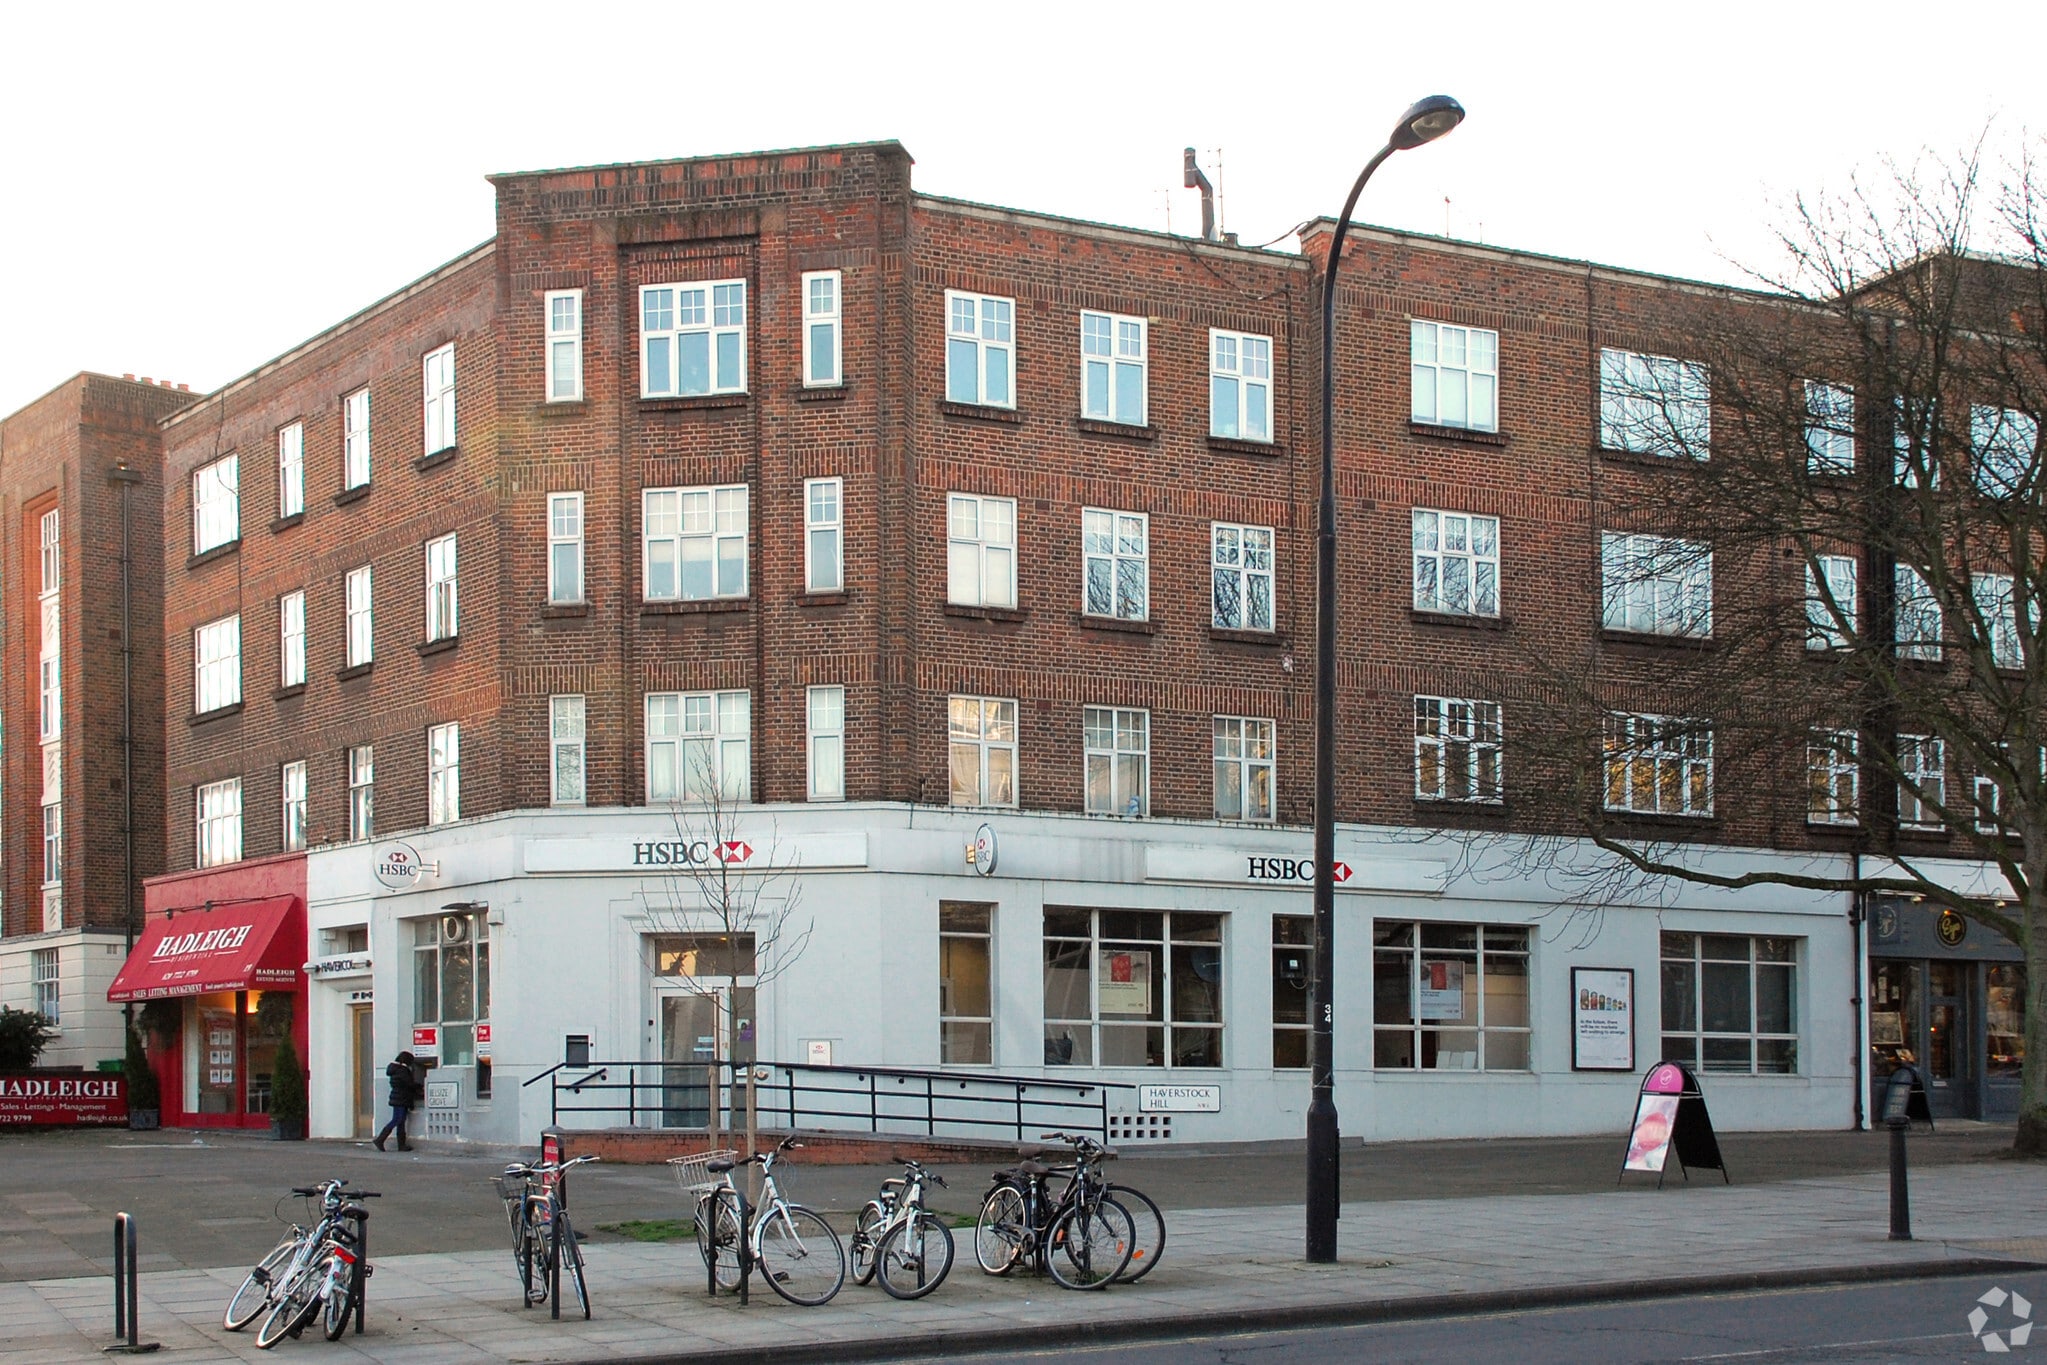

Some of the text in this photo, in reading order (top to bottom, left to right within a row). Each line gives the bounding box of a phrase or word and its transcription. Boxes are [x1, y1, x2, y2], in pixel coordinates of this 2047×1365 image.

[632, 842, 709, 865] HSBC
[380, 864, 417, 876] HSBC
[1247, 857, 1315, 881] HSBC
[152, 925, 253, 957] HADLEIGH
[133, 988, 147, 999] SALES
[169, 983, 203, 995] MANAGEMENT
[1150, 1089, 1210, 1098] HAVERSTOCK
[25, 1103, 54, 1112] Lettings
[60, 1103, 106, 1112] Management
[1150, 1100, 1169, 1108] HILL
[77, 1114, 128, 1122] hadleigh.co.uk
